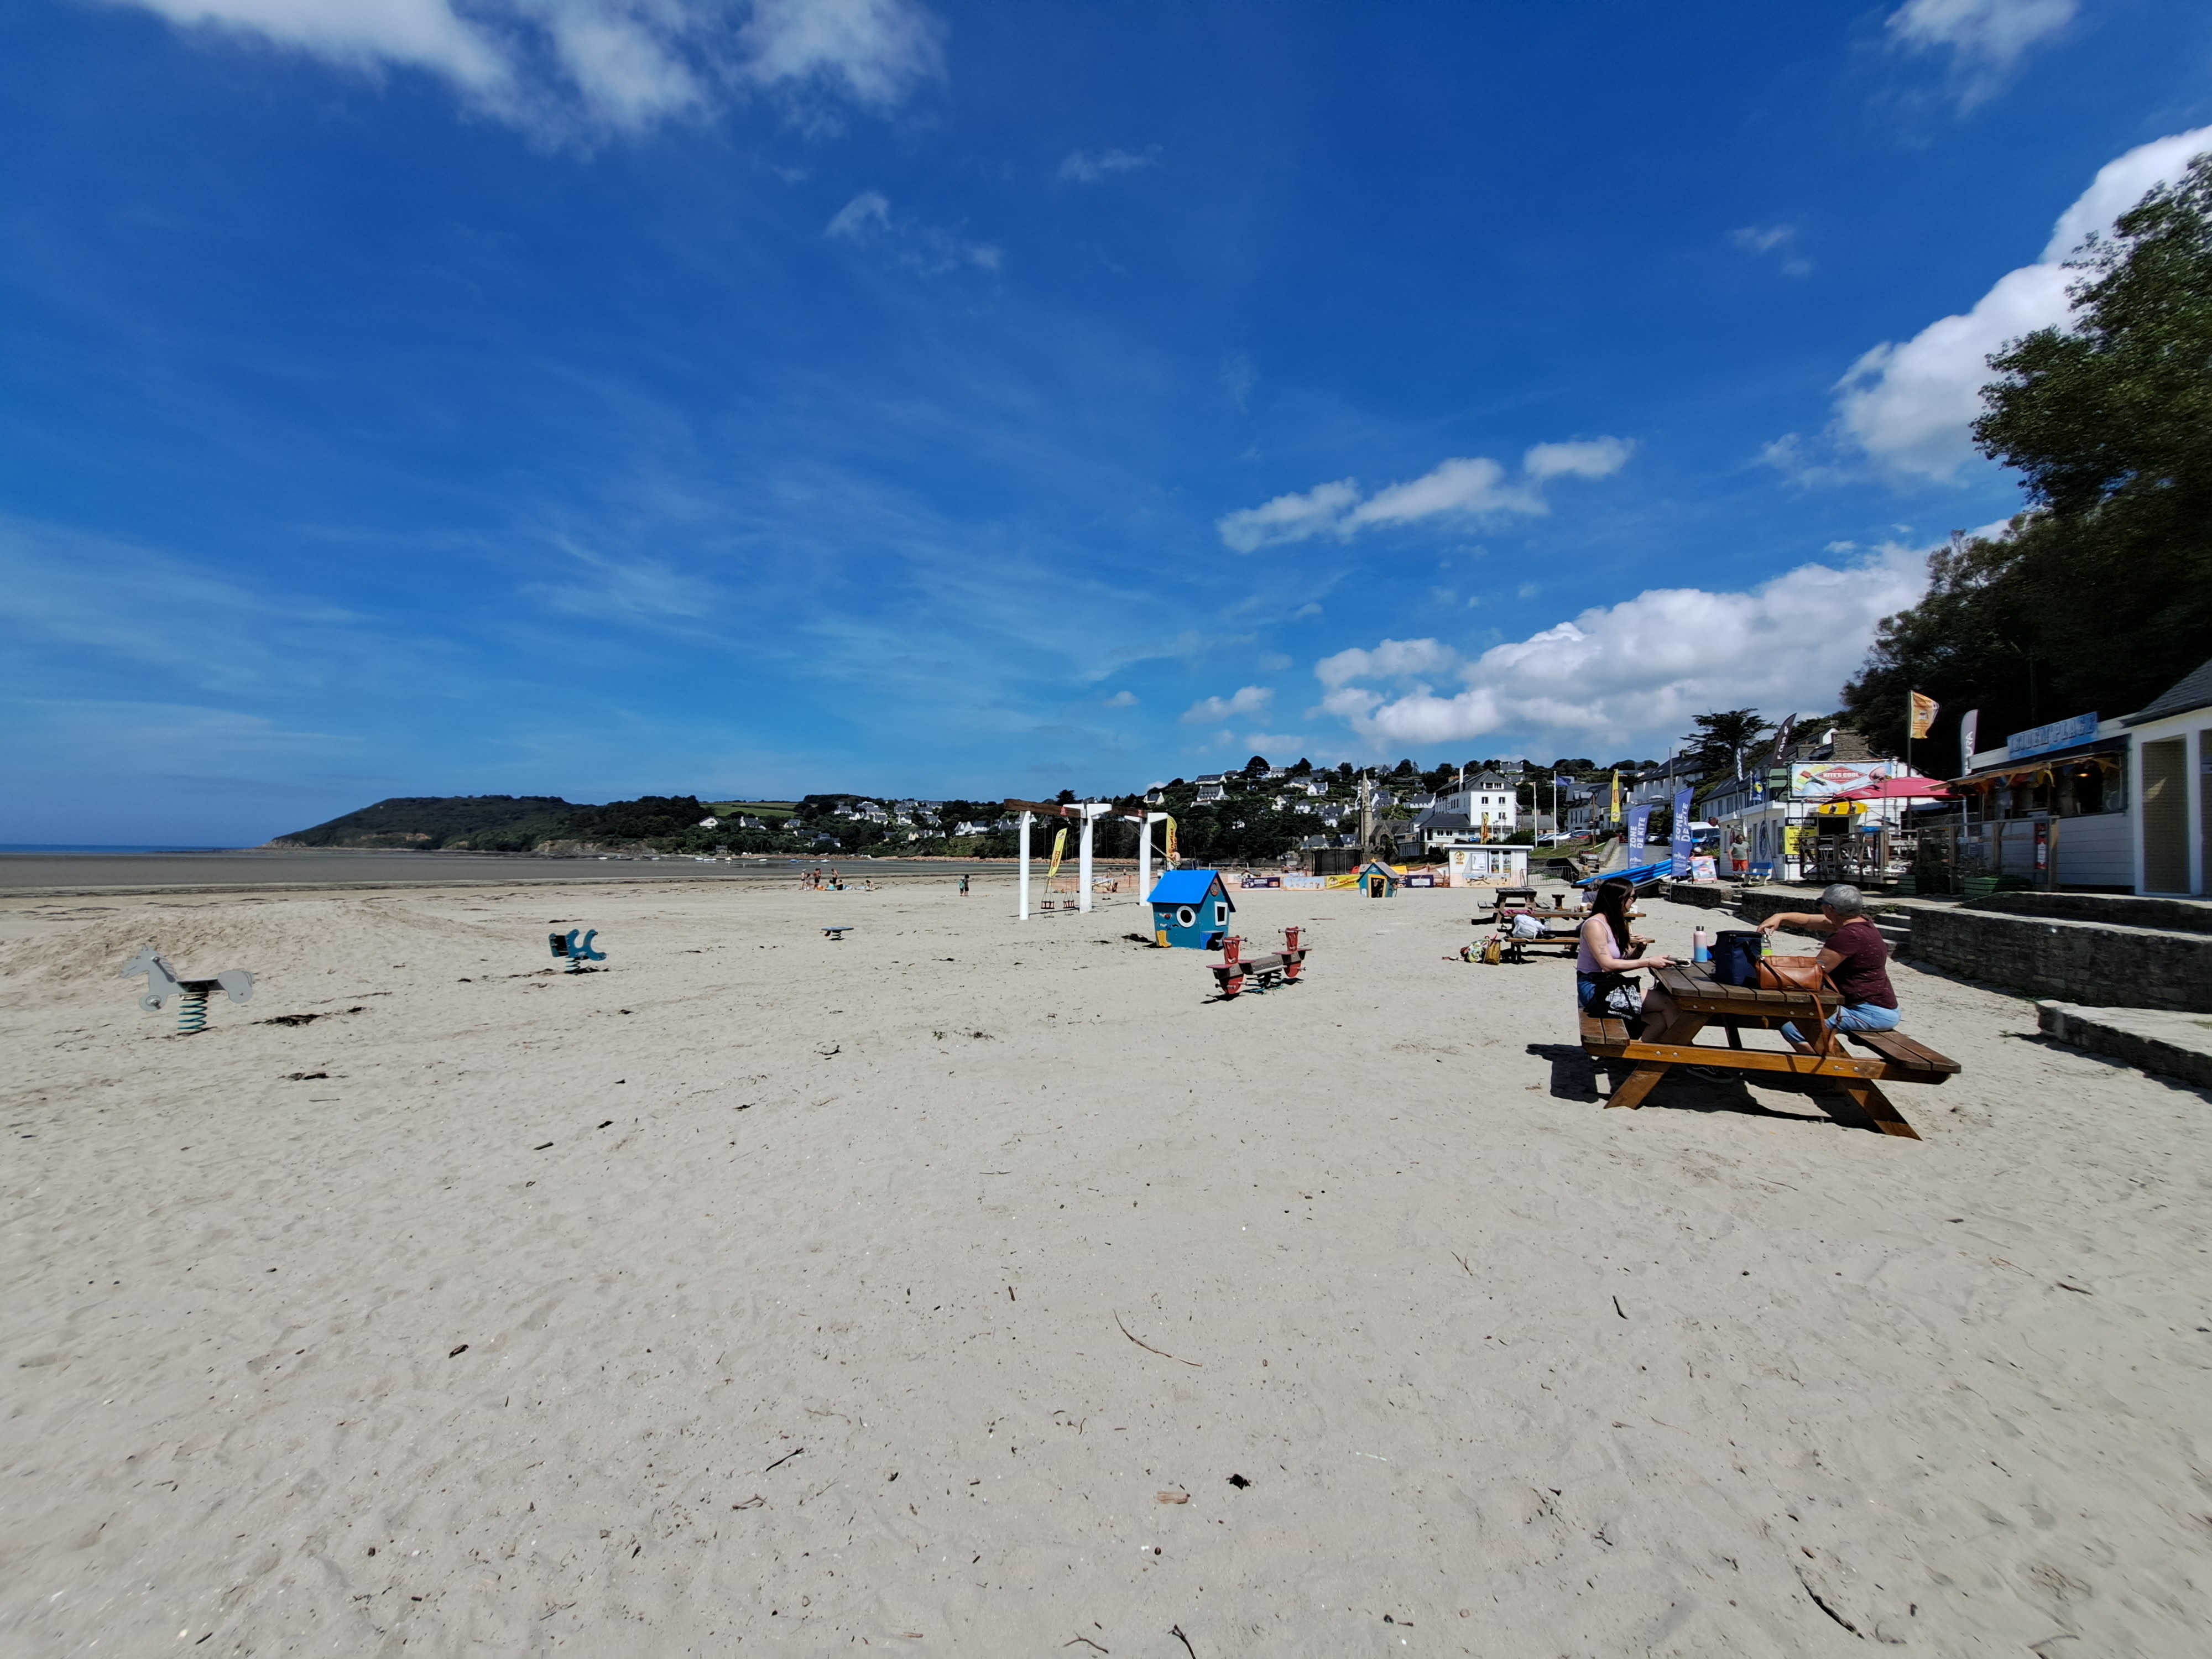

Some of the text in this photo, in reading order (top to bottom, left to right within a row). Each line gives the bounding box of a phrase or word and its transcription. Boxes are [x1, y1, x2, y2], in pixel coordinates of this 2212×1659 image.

[1637, 817, 1646, 848] DE KITE
[1681, 828, 1691, 842] DE
